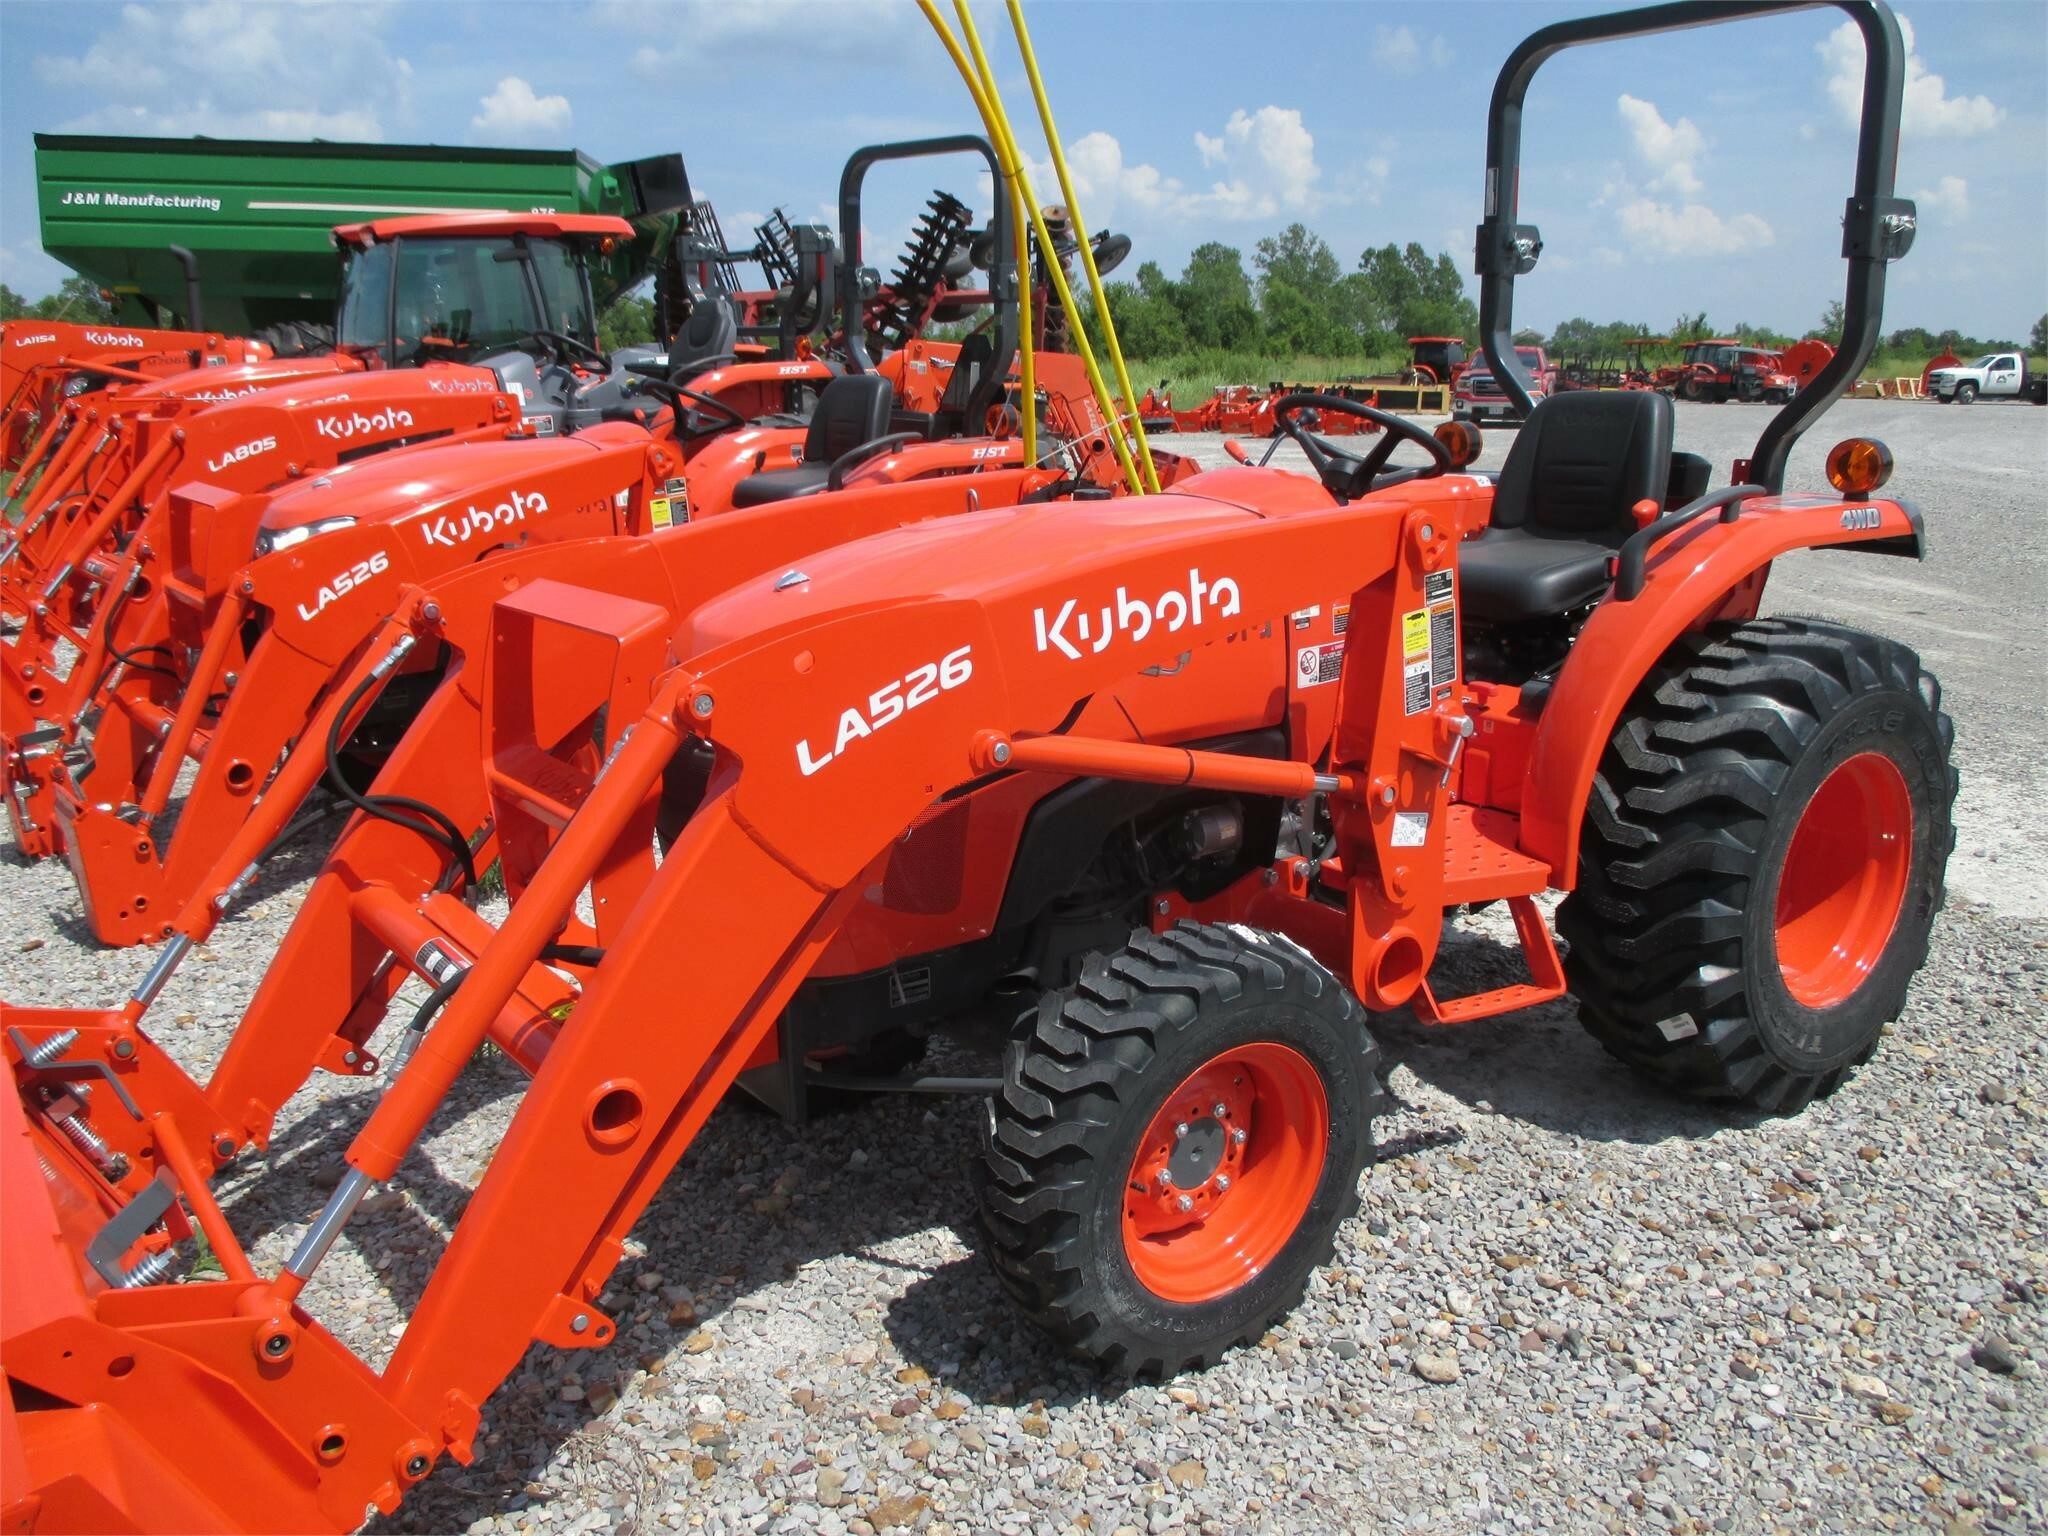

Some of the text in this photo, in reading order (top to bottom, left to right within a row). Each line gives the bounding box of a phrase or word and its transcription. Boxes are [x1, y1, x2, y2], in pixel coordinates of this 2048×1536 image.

[62, 192, 221, 211] J&M Manufacturing
[86, 331, 144, 347] Kubota
[777, 365, 810, 375] HST
[429, 378, 495, 394] Kubota
[317, 406, 414, 439] Kubota
[208, 436, 277, 473] LA805
[972, 446, 1009, 459] HST
[421, 490, 549, 546] Kubota
[1840, 508, 1880, 530] 4WD
[297, 550, 389, 621] LA526
[1033, 567, 1241, 660] Kubota
[796, 644, 973, 776] LA526
